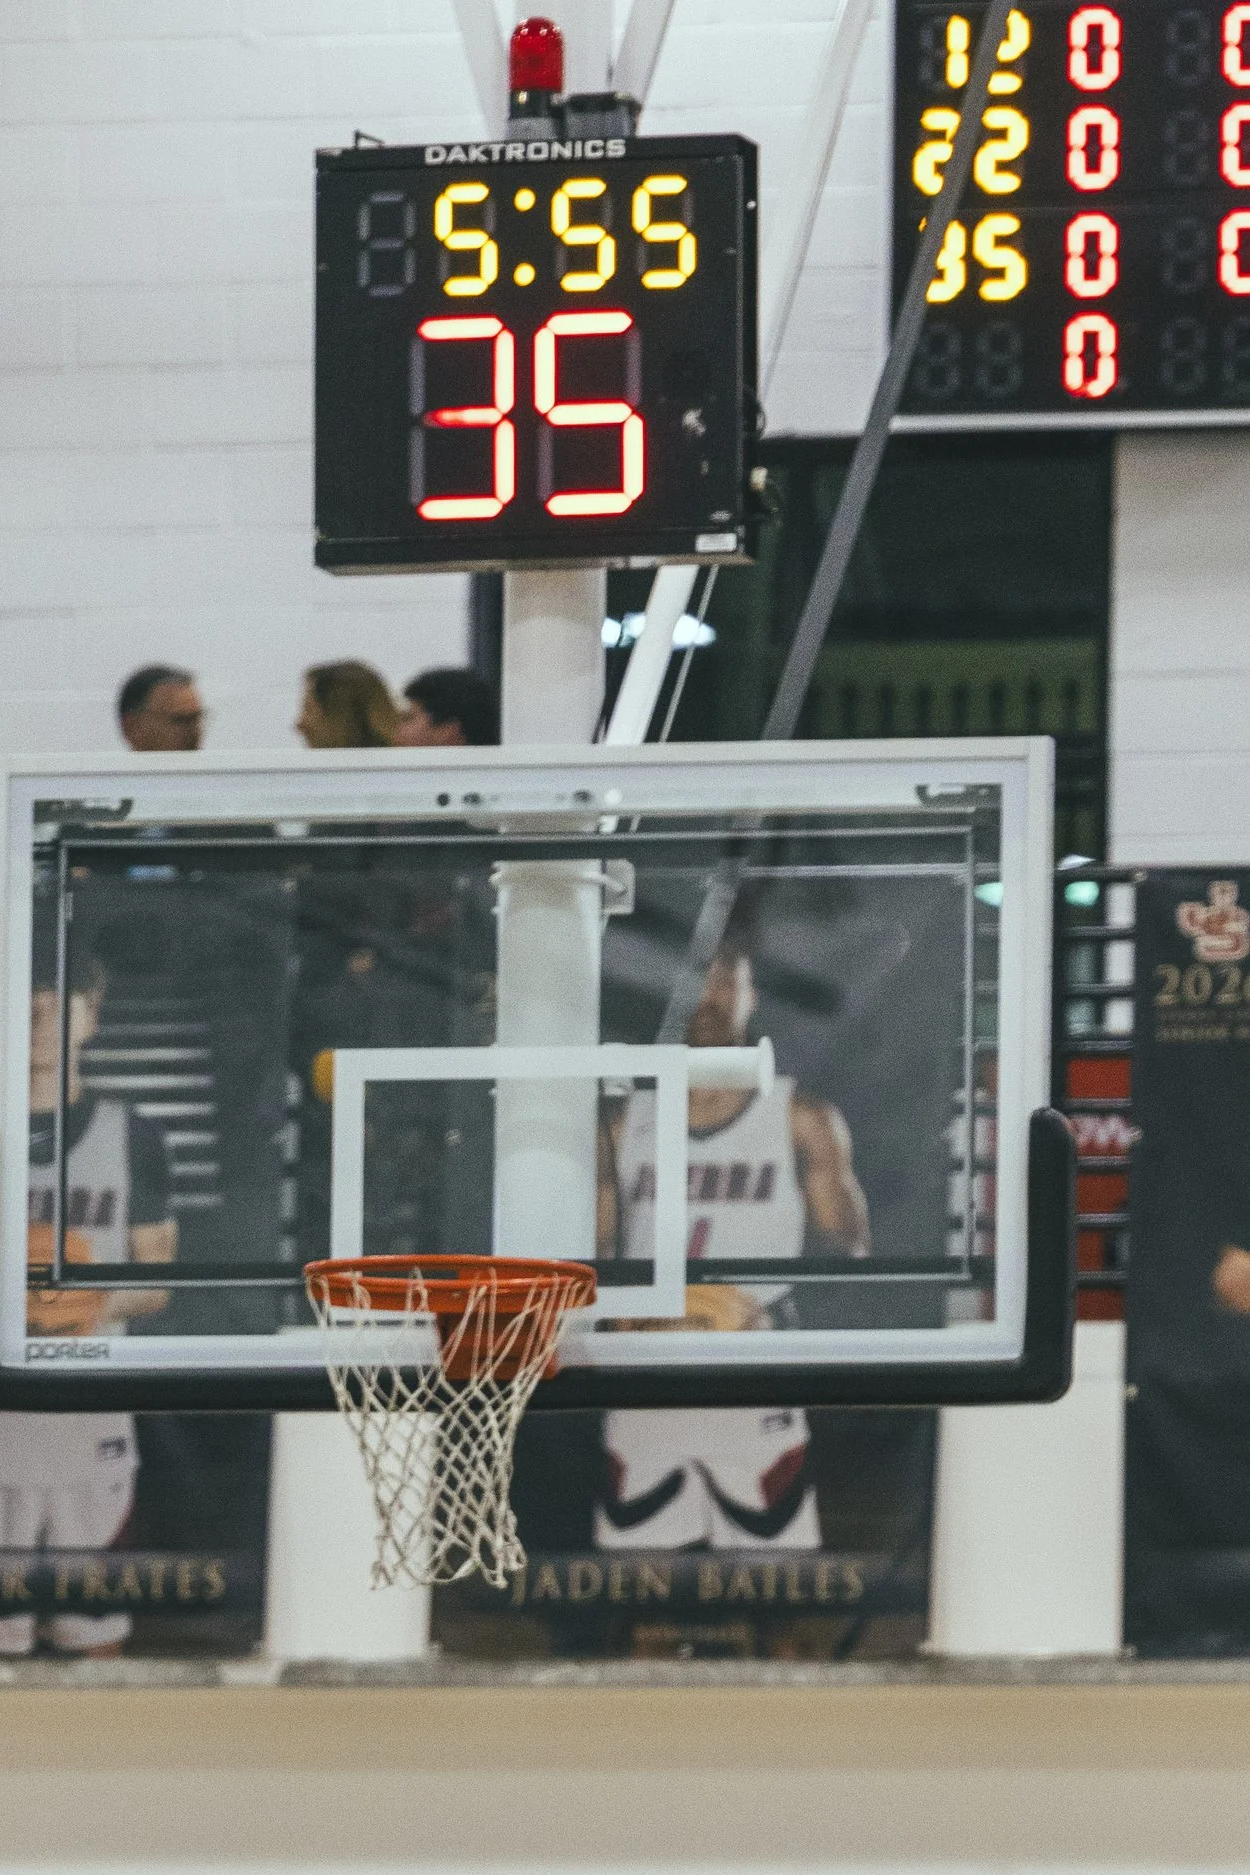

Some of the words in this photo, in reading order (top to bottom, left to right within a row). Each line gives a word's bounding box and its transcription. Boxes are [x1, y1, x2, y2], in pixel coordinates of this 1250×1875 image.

[1068, 3, 1122, 92] 0
[424, 139, 627, 165] DAKTRONICS
[1065, 102, 1120, 192] 0
[434, 174, 698, 297] 5:55
[1063, 210, 1119, 299] 0
[1061, 310, 1118, 399] 0
[416, 309, 645, 521] 35
